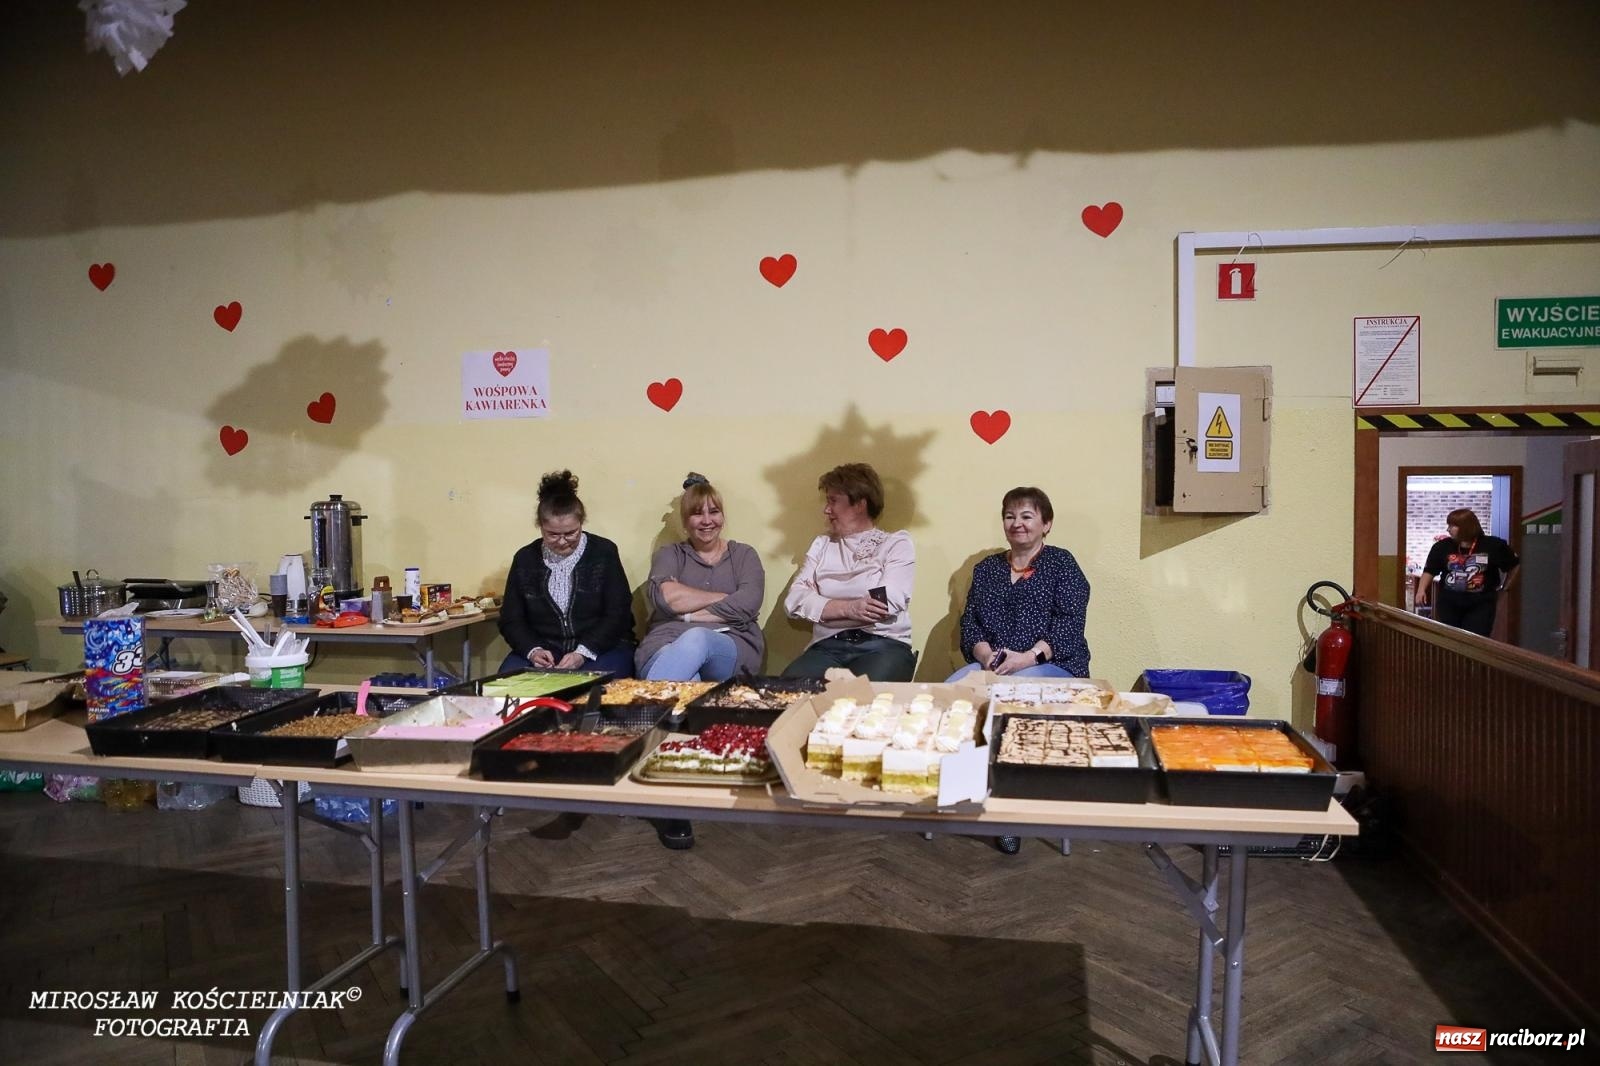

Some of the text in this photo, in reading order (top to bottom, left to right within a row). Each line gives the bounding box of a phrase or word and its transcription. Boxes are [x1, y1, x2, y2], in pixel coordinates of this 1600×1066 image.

[1506, 303, 1600, 323] WYJŚCIE
[1501, 327, 1600, 339] EWAKUACYJNE
[473, 384, 538, 397] WOŚPOWA
[465, 399, 547, 411] KAWIARENKA
